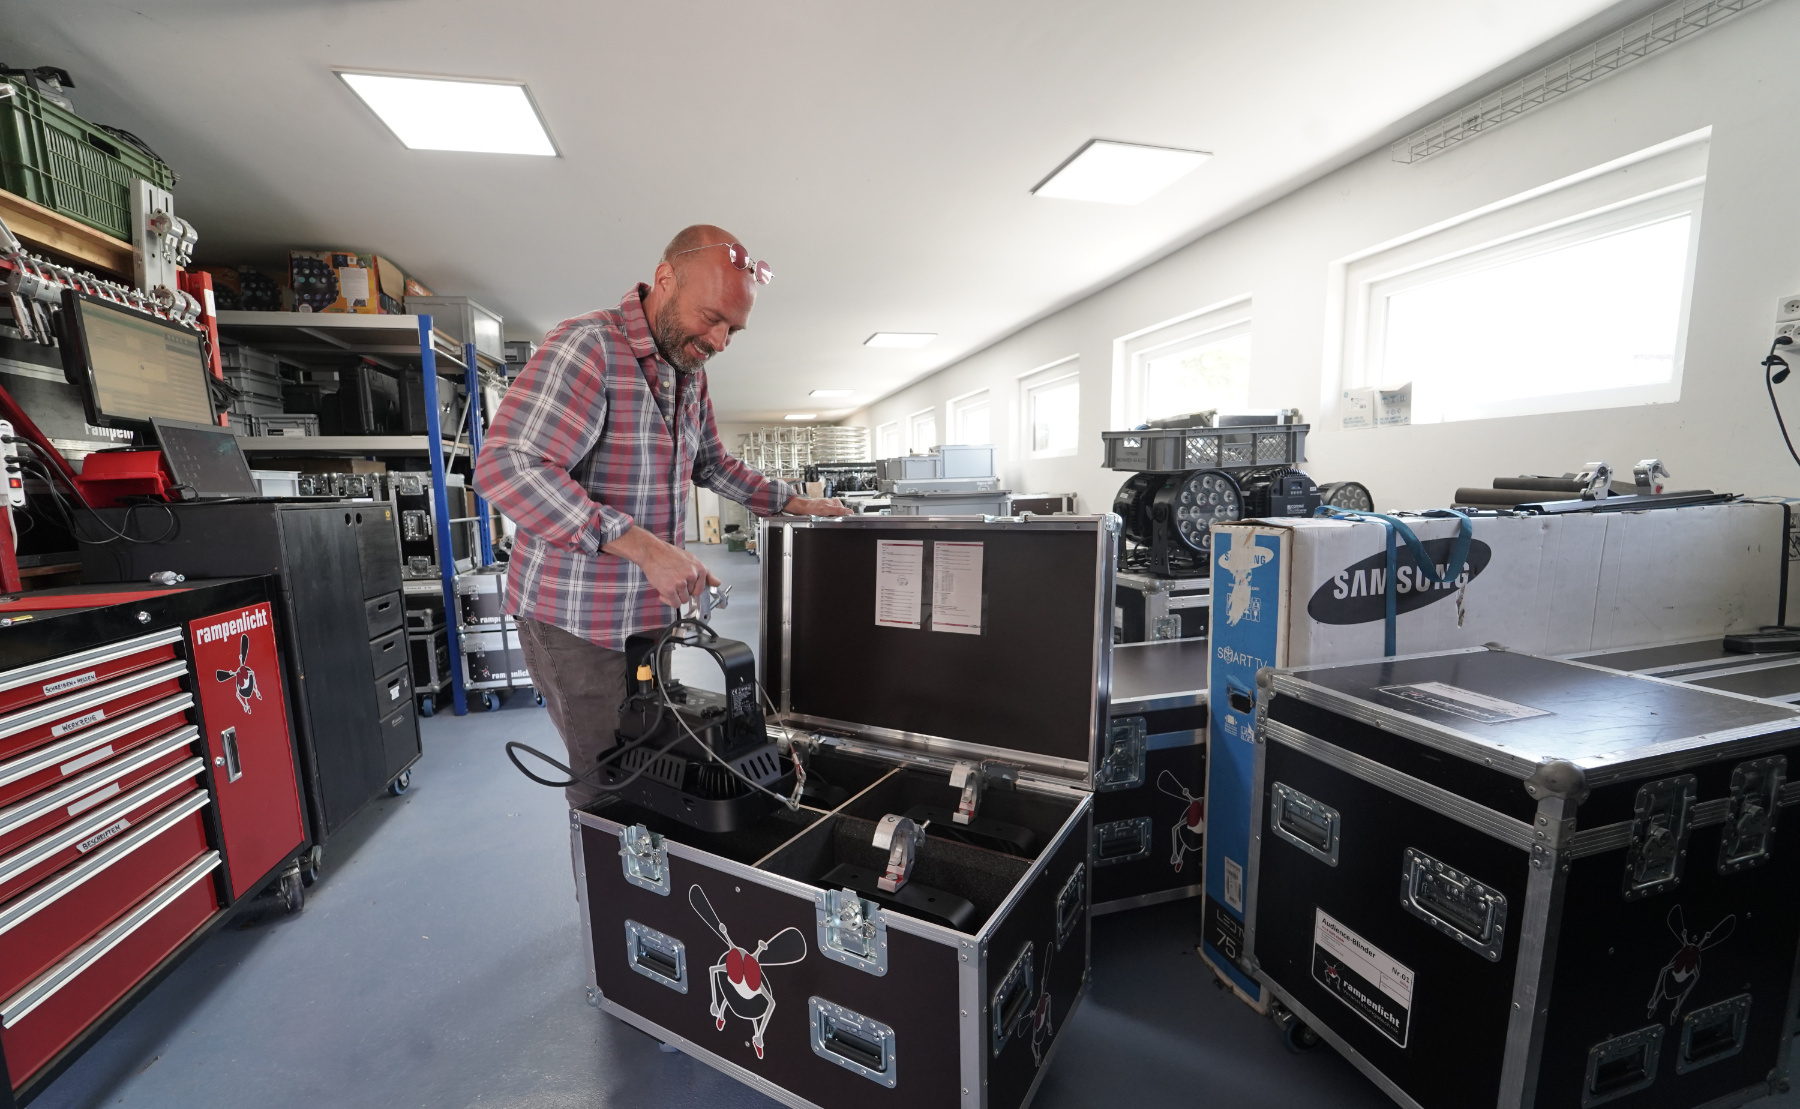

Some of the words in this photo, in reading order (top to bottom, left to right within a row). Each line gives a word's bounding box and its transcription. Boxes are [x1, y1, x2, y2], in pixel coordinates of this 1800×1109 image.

[1333, 561, 1470, 600] SAMSUNG
[196, 608, 268, 645] rampenlicht
[1254, 657, 1268, 670] TV
[61, 714, 98, 732] WERKZEUG
[82, 824, 121, 850] BESCHRIFTEN
[1216, 927, 1237, 959] 75
[1322, 917, 1376, 958] Audience-Blinder
[1343, 980, 1400, 1028] rampenlicht
